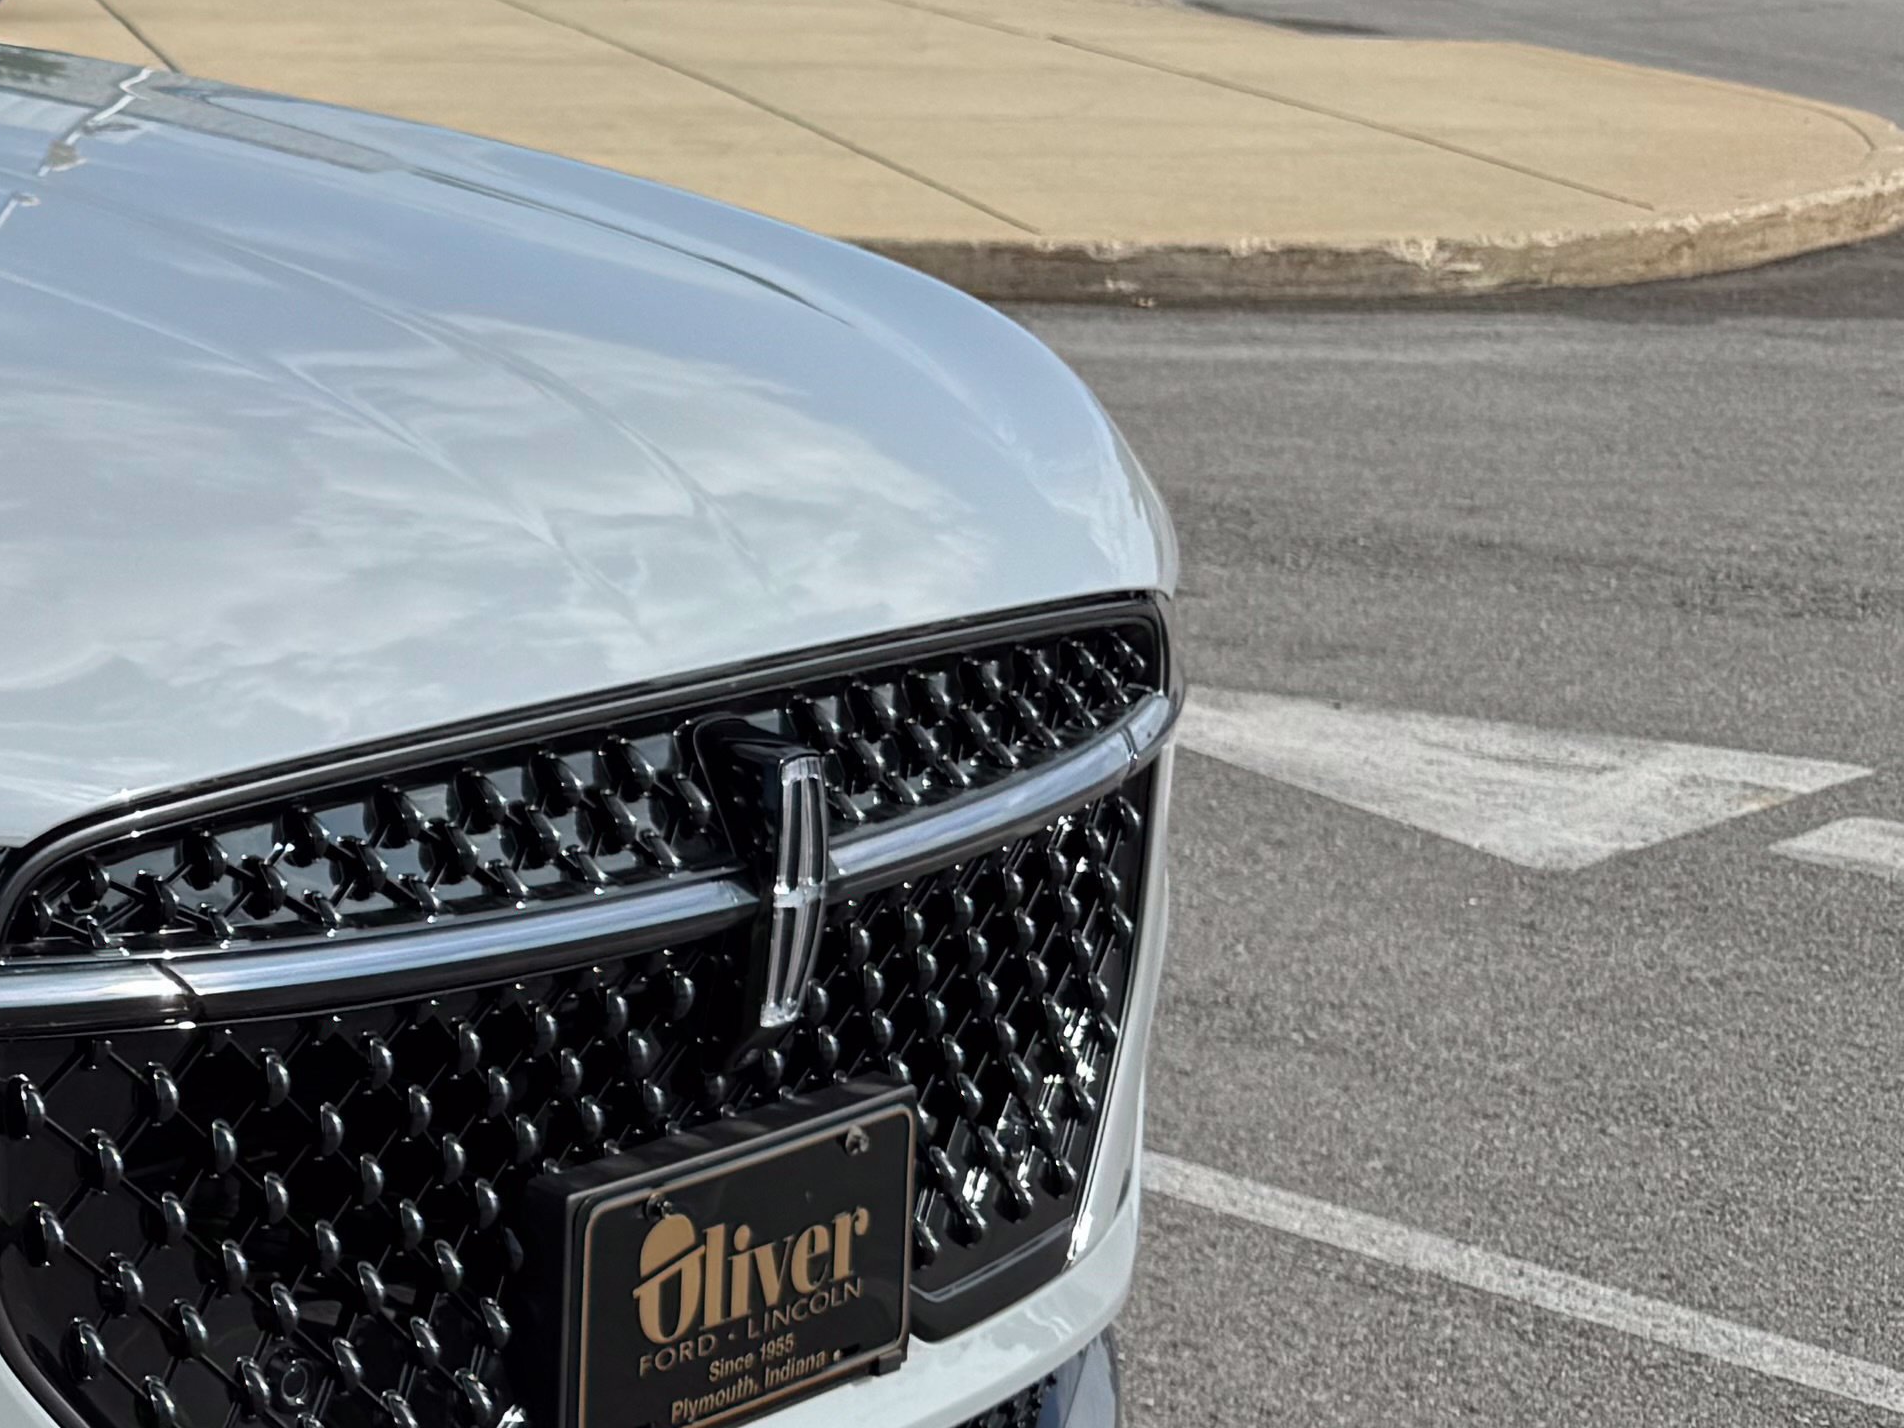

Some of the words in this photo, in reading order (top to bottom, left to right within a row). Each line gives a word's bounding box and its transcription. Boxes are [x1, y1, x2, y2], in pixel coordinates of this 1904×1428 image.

[632, 1207, 869, 1344] Oliver
[639, 1333, 717, 1376] FORD
[748, 1277, 864, 1340] LINCOLN
[709, 1351, 753, 1382] Since
[761, 1333, 794, 1362] 1955
[765, 1349, 826, 1390] Indiana
